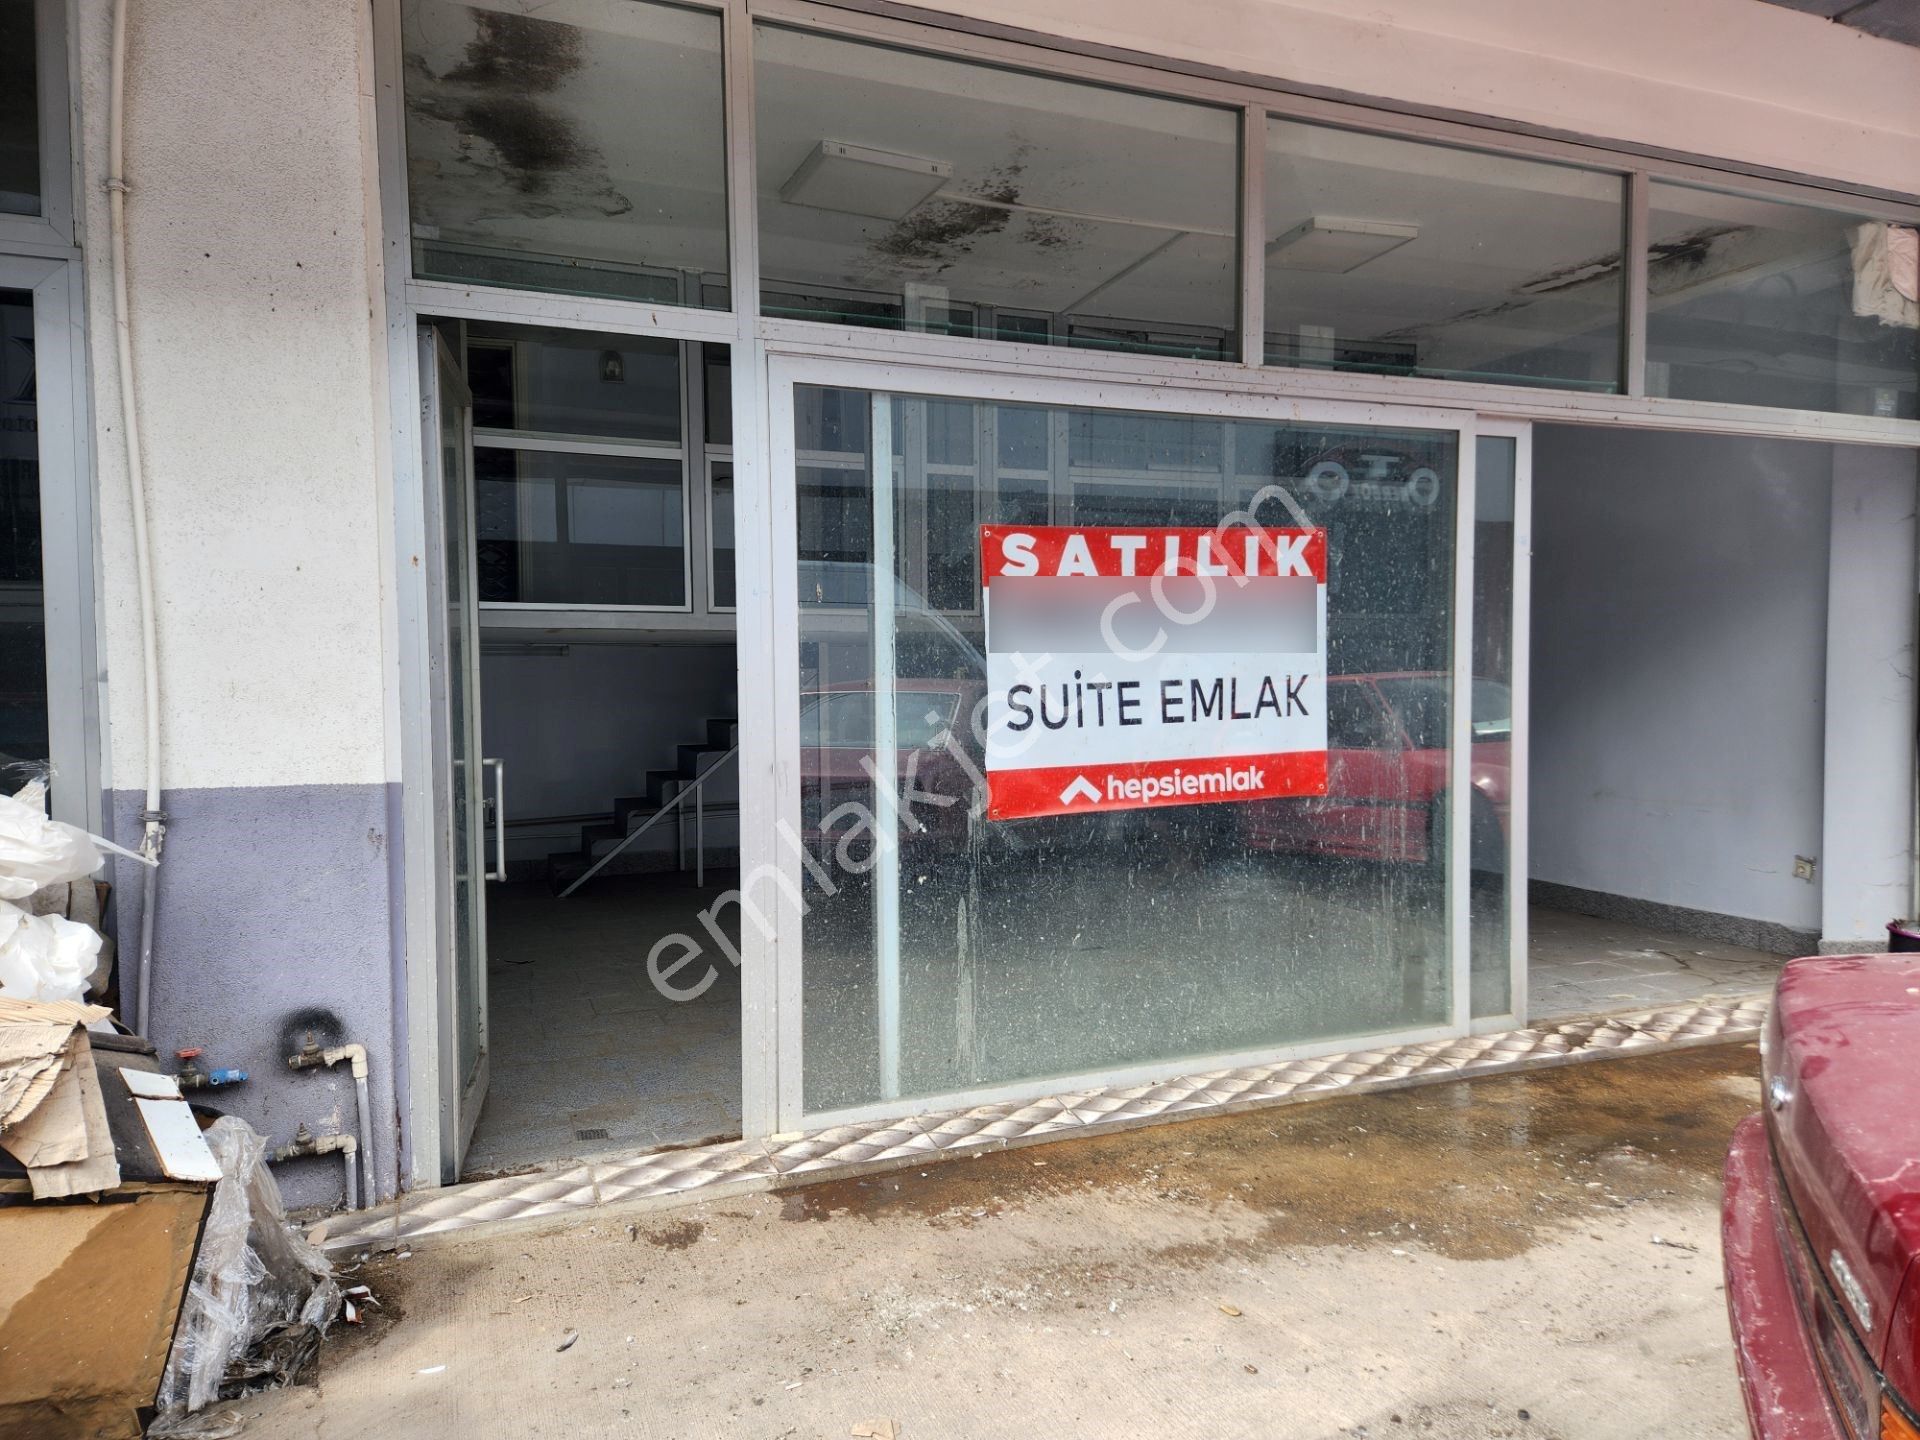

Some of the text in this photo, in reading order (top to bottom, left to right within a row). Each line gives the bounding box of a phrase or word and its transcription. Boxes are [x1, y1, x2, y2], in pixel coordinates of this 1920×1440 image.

[1000, 533, 1313, 577] SATILIK
[1006, 669, 1309, 732] SUİTE EMLAK
[1107, 766, 1265, 803] hepsiemlak
